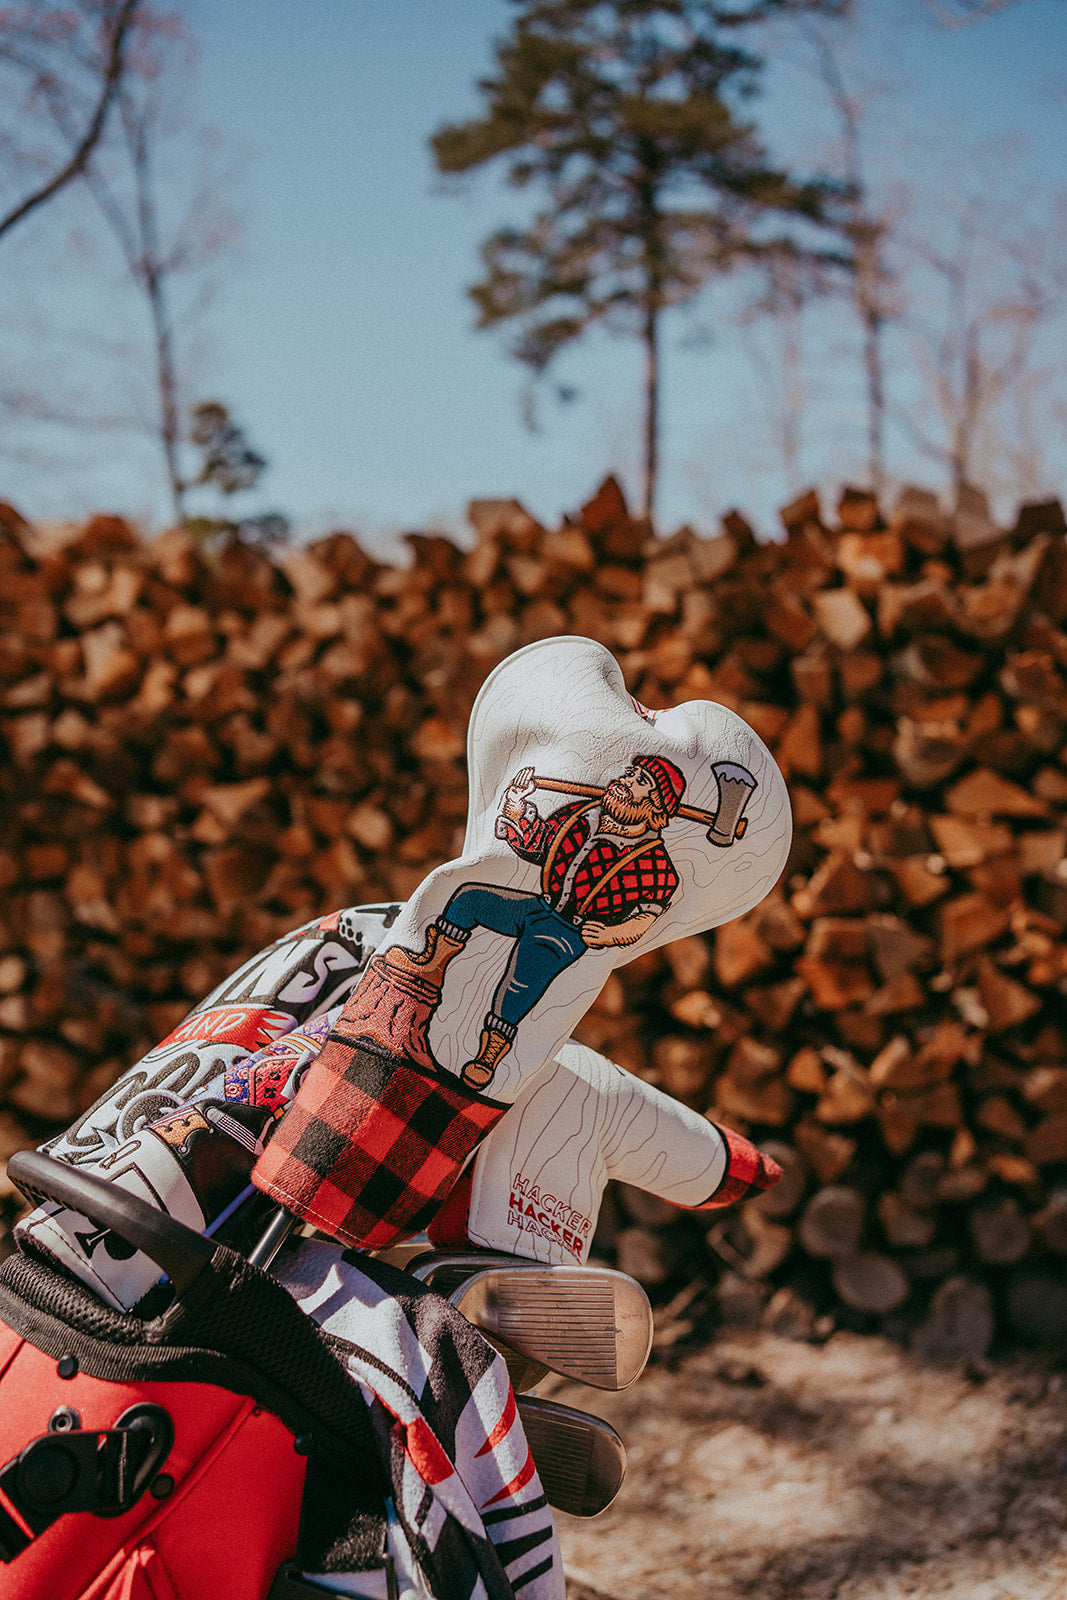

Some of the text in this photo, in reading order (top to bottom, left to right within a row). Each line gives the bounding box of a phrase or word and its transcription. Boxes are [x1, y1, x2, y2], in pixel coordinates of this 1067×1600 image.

[174, 1012, 247, 1039] AND
[509, 1192, 583, 1257] HACKER
[513, 1173, 592, 1238] HACKER
[507, 1210, 582, 1266] HAC
